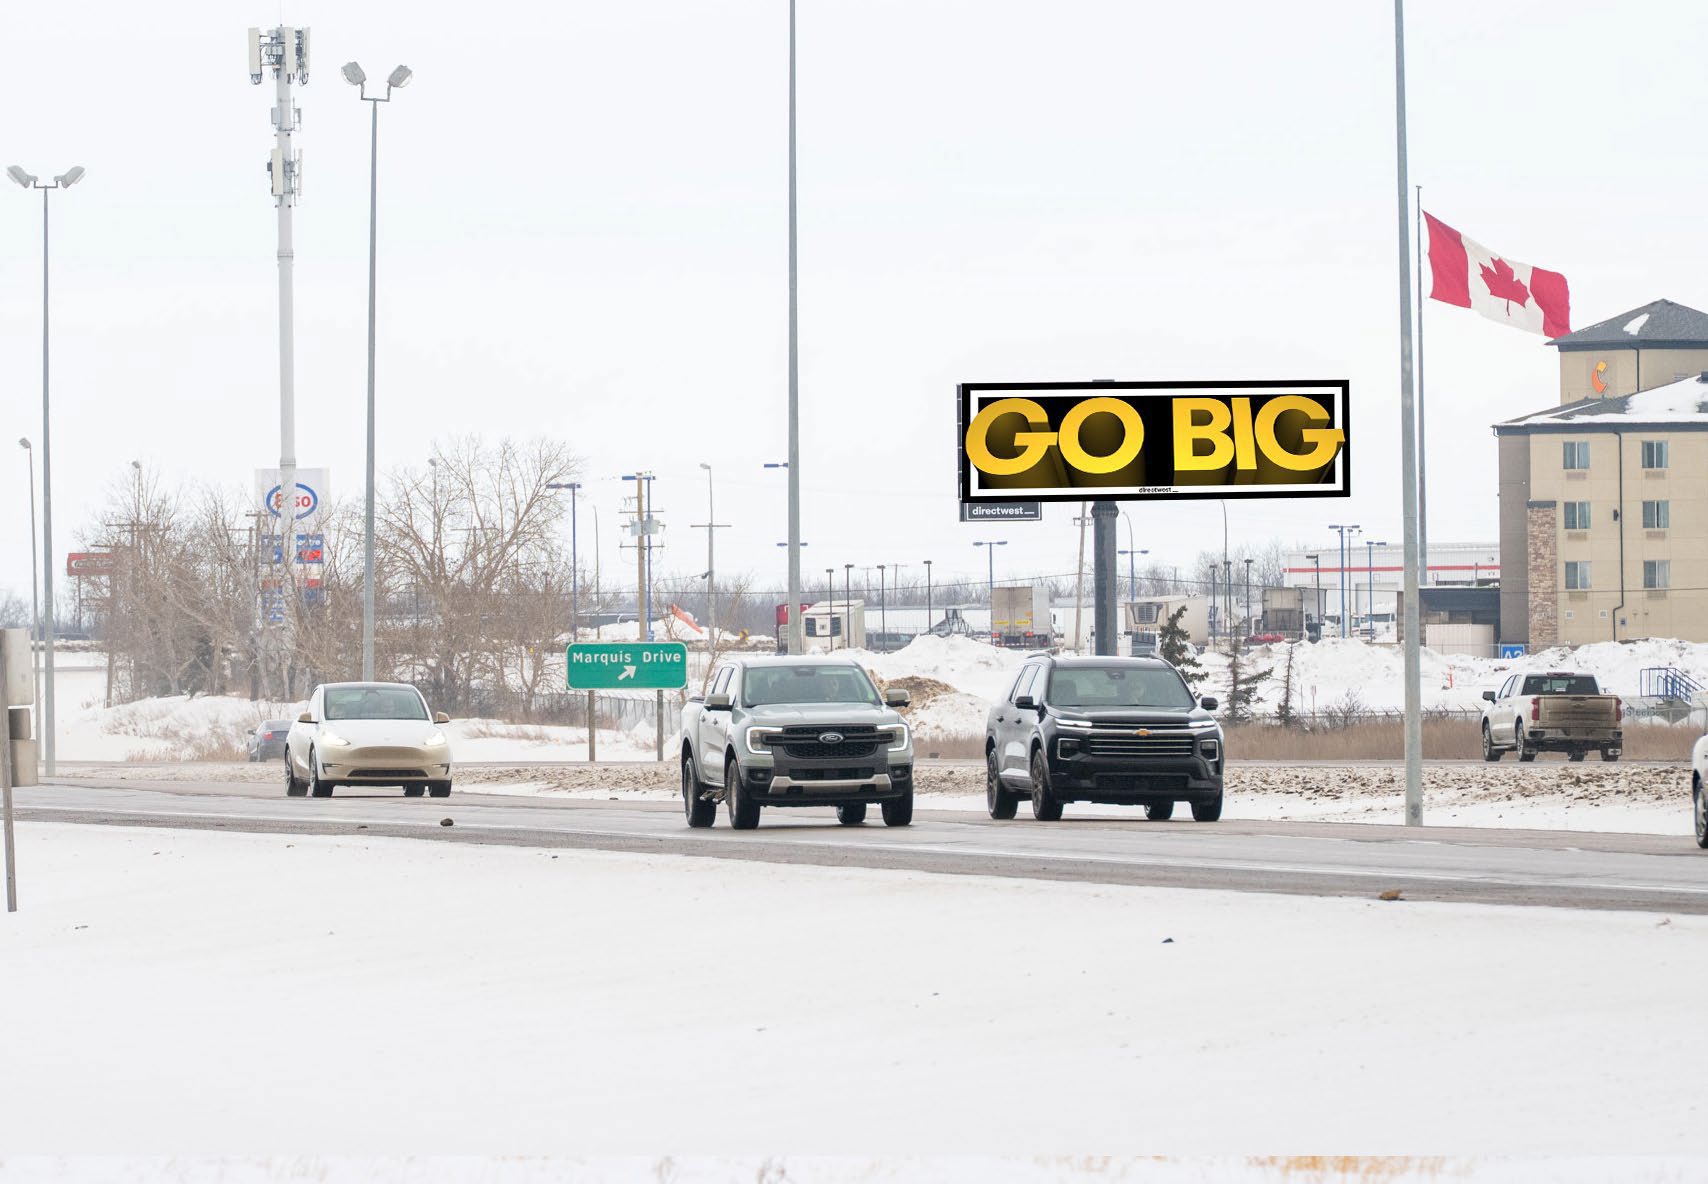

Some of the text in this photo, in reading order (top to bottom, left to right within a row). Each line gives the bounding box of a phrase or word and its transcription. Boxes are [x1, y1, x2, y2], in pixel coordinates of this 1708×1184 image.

[966, 395, 1345, 475] GO BIG
[573, 650, 681, 665] Marquis Drive
